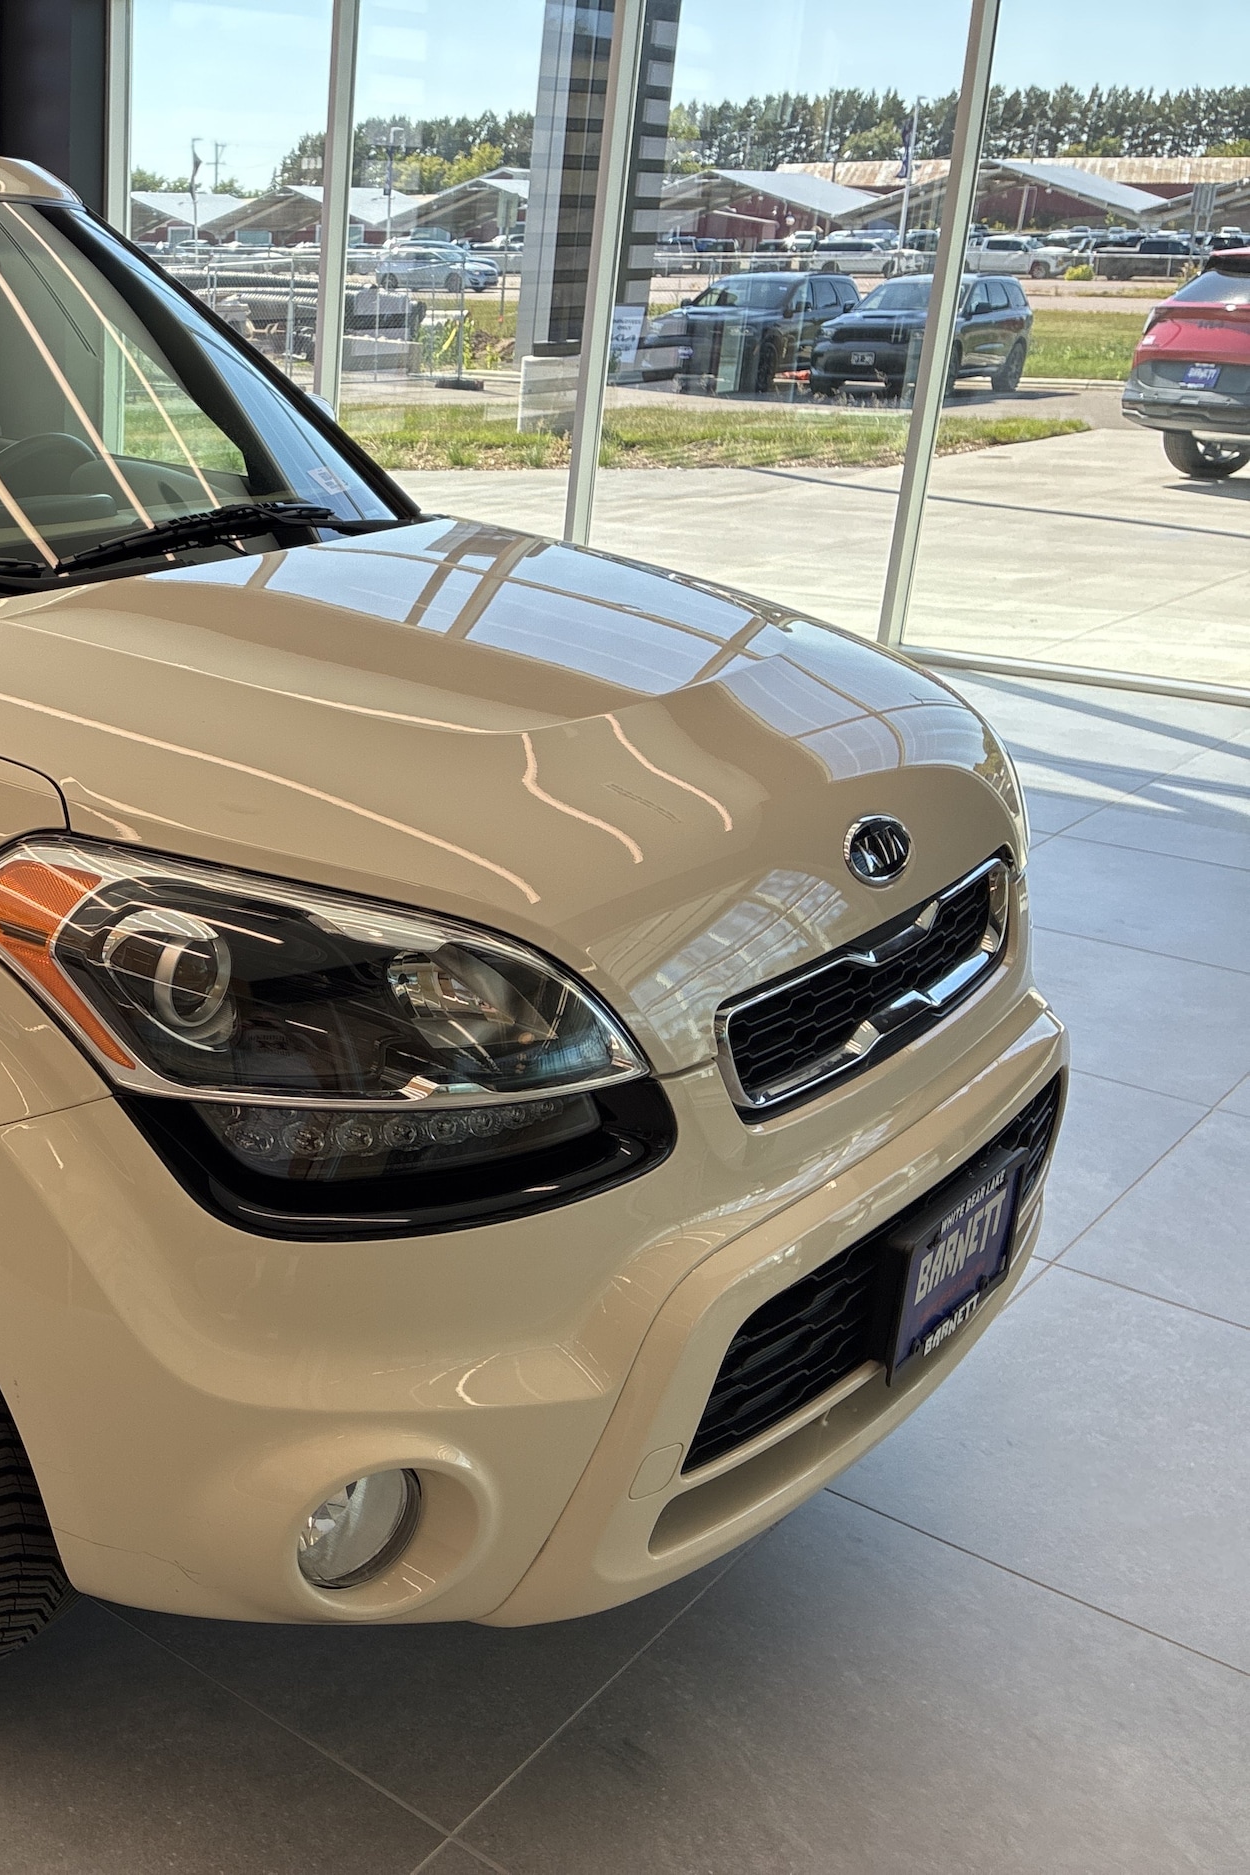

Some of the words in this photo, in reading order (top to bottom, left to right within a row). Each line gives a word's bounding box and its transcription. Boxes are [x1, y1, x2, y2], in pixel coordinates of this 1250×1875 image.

[940, 1202, 966, 1235] WHITE
[965, 1185, 986, 1213] BEAR
[986, 1168, 1006, 1196] LAKE
[914, 1187, 1007, 1306] BARNETT
[923, 1292, 980, 1357] BARNETT
